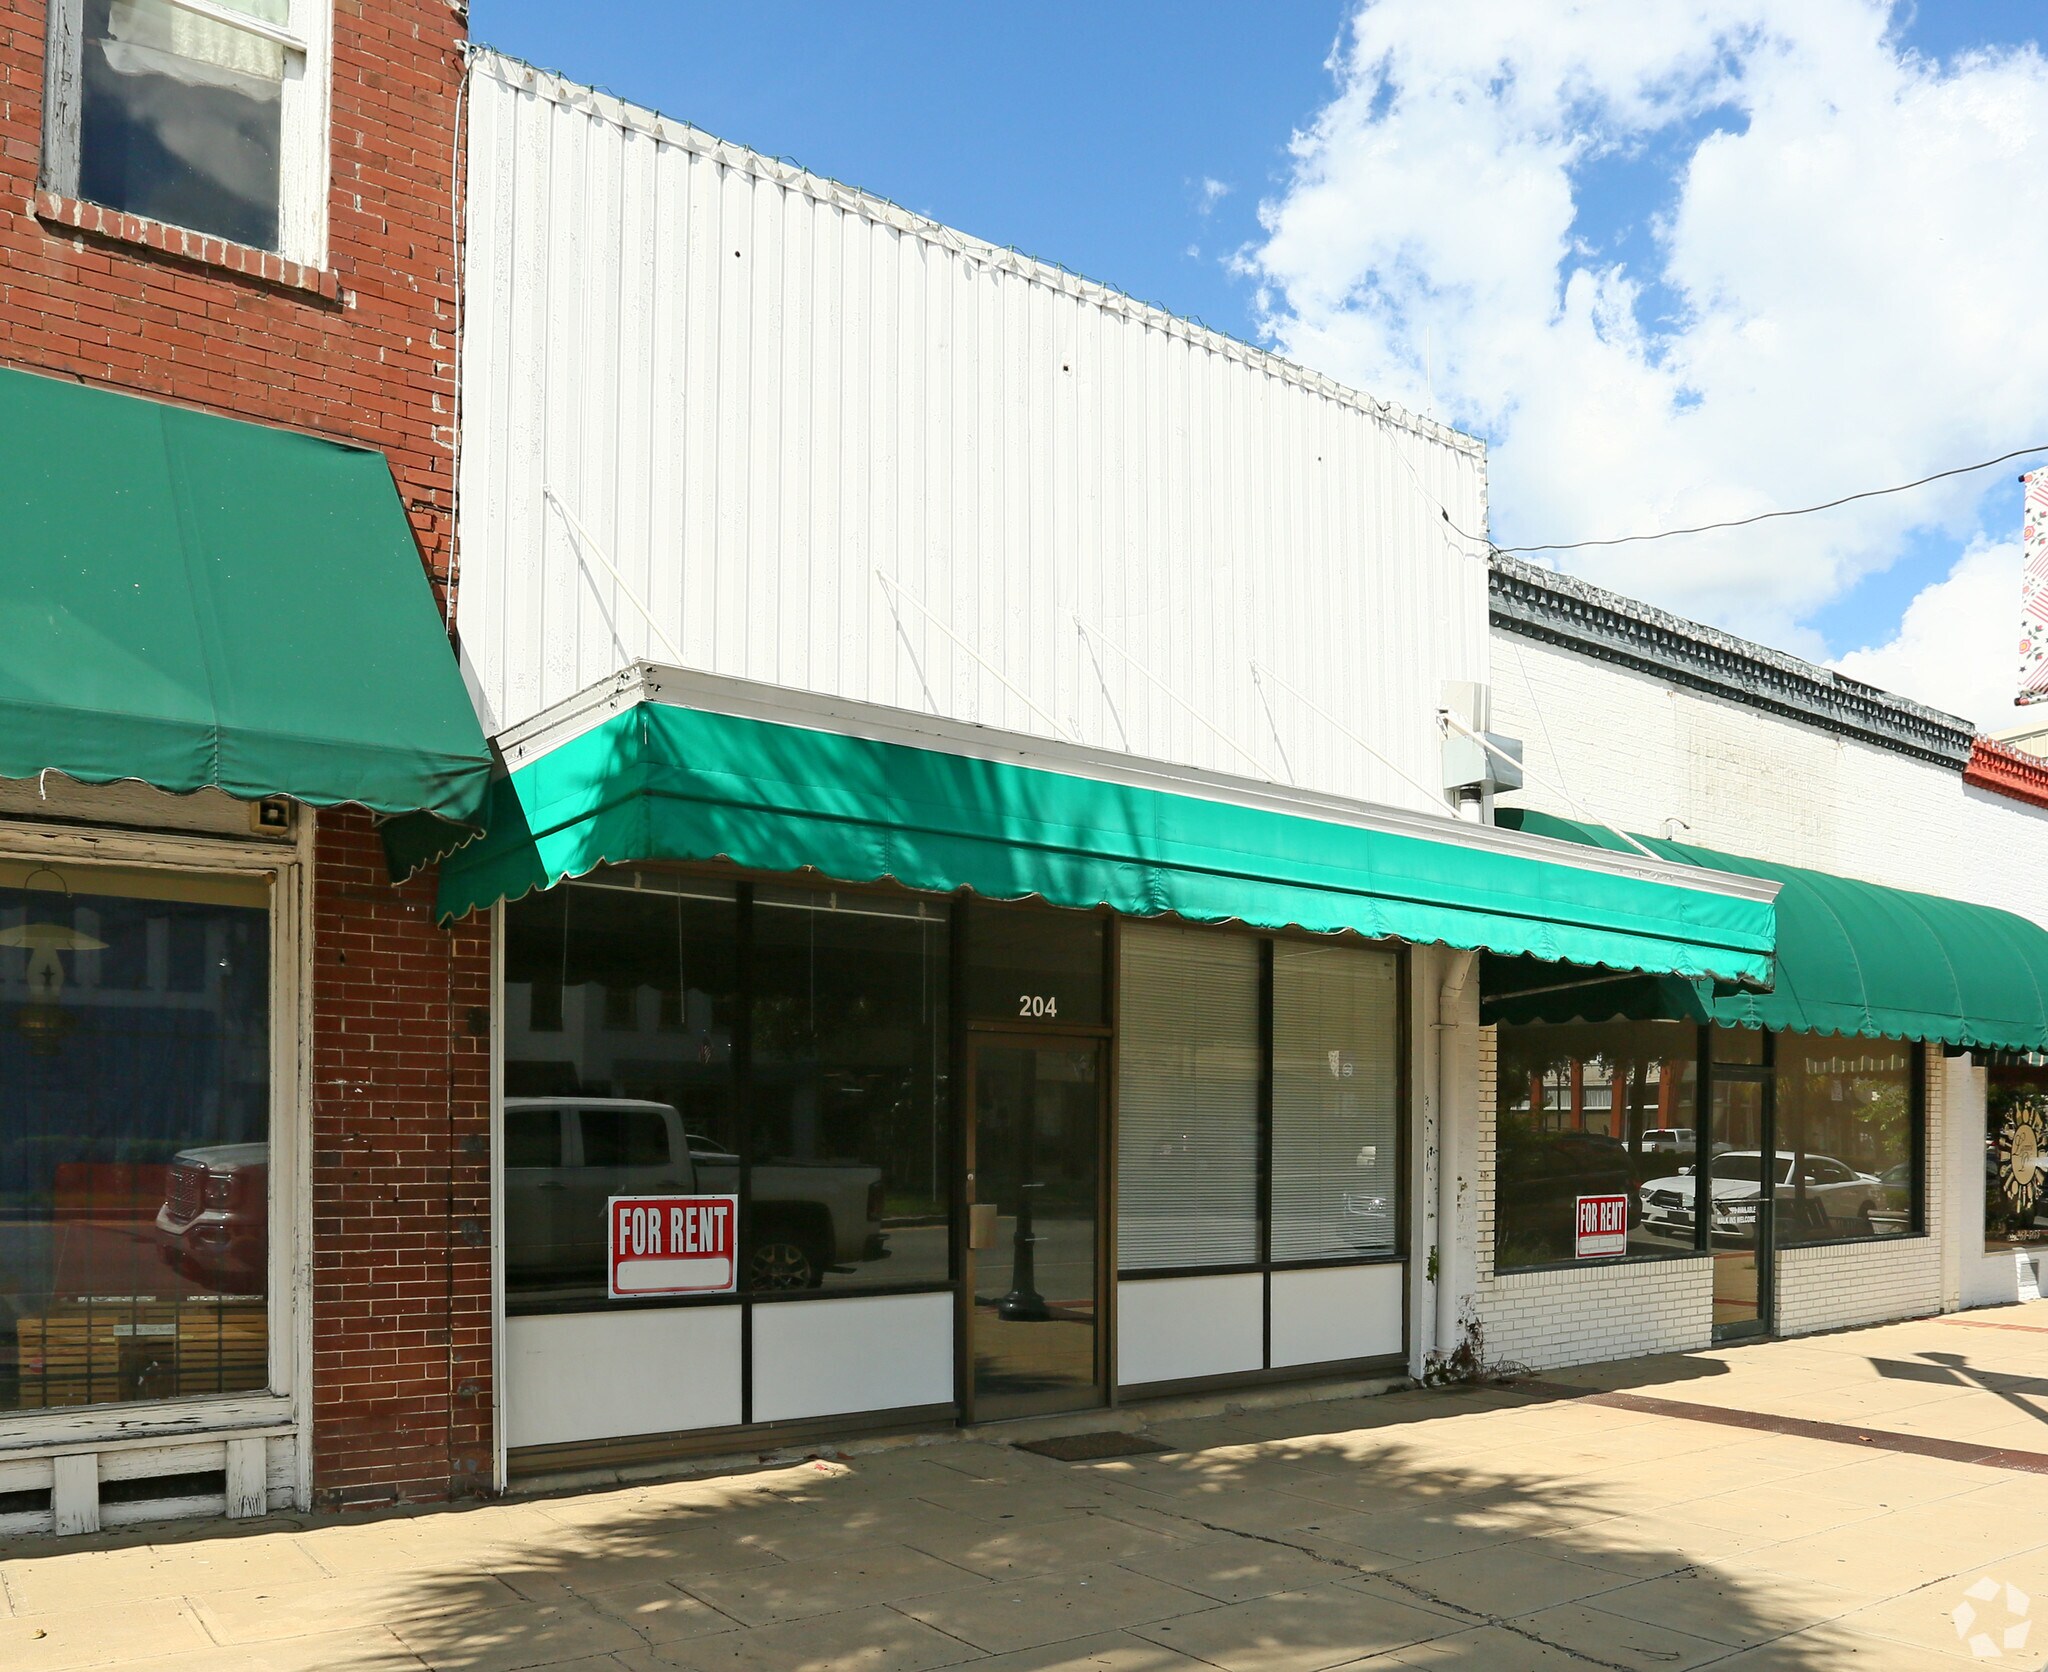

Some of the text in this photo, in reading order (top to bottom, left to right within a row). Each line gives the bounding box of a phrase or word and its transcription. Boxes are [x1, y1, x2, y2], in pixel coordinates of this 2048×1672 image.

[1019, 995, 1057, 1017] 204
[619, 1206, 728, 1255] FOR RENT
[1580, 1201, 1624, 1233] FOR RENT
[1737, 1215, 1756, 1224] WELCOME
